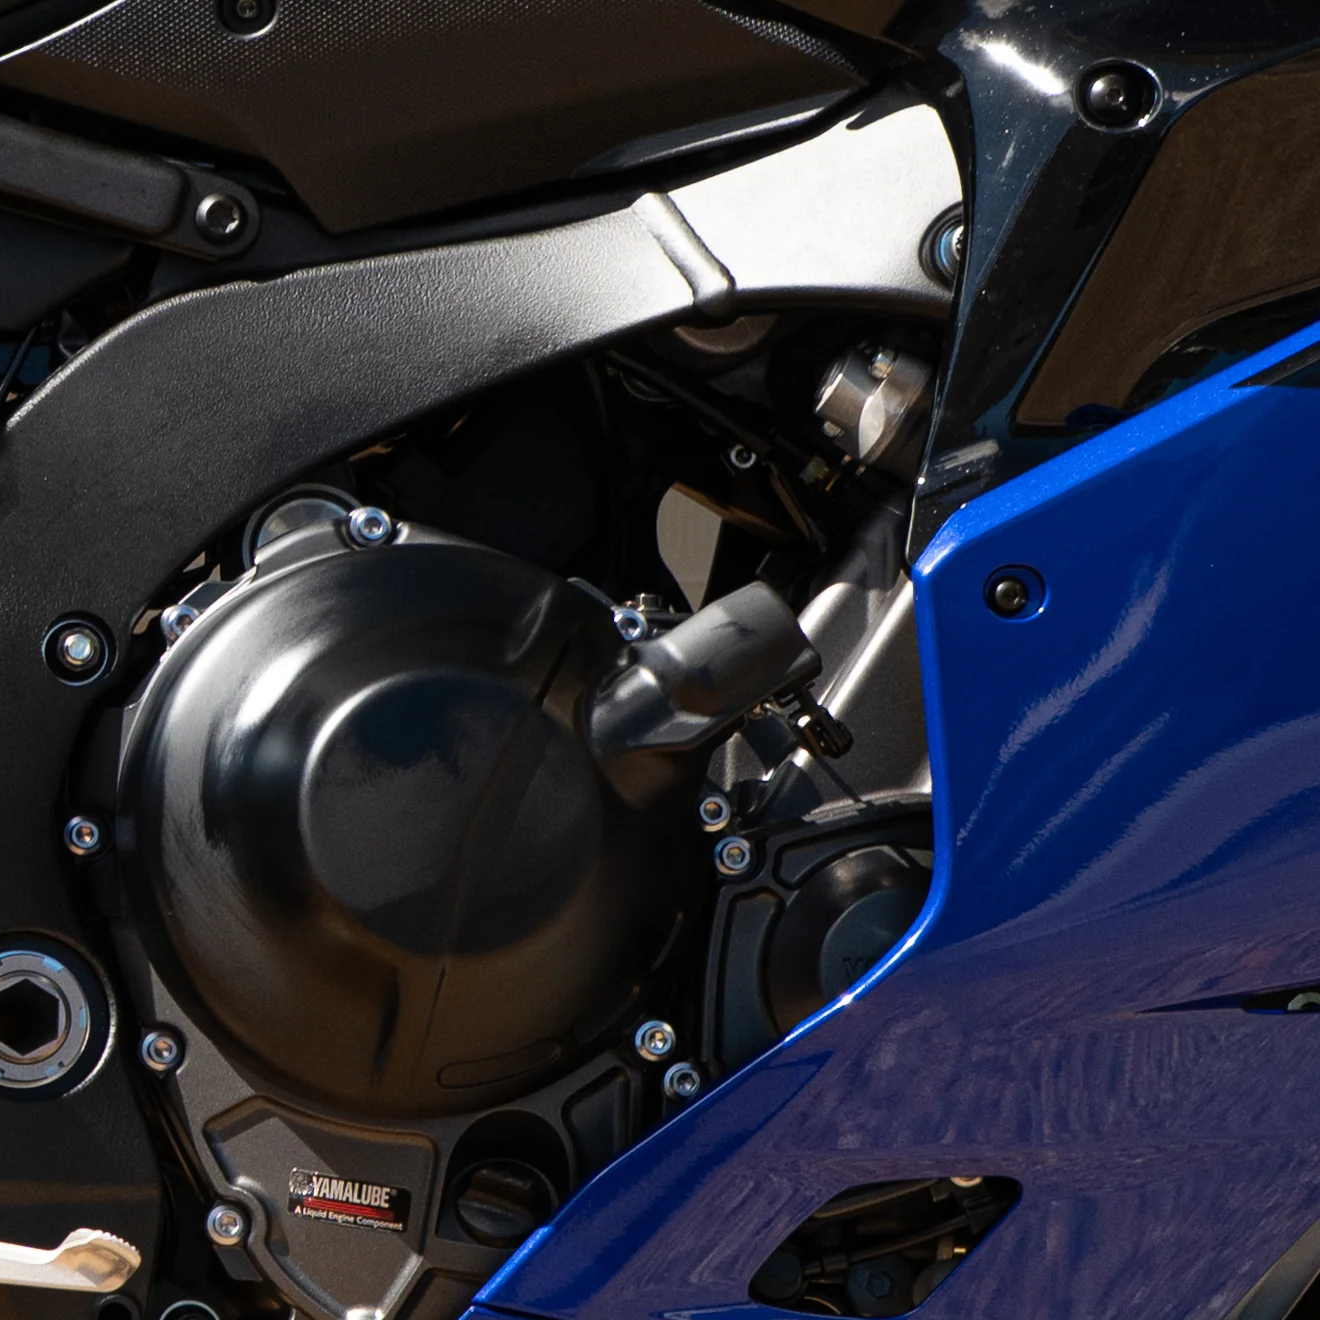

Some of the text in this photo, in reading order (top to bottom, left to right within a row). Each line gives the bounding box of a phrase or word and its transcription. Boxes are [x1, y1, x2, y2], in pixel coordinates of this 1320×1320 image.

[312, 1175, 390, 1208] YAMALUBE
[294, 1205, 403, 1231] A Liquid Engine Component
